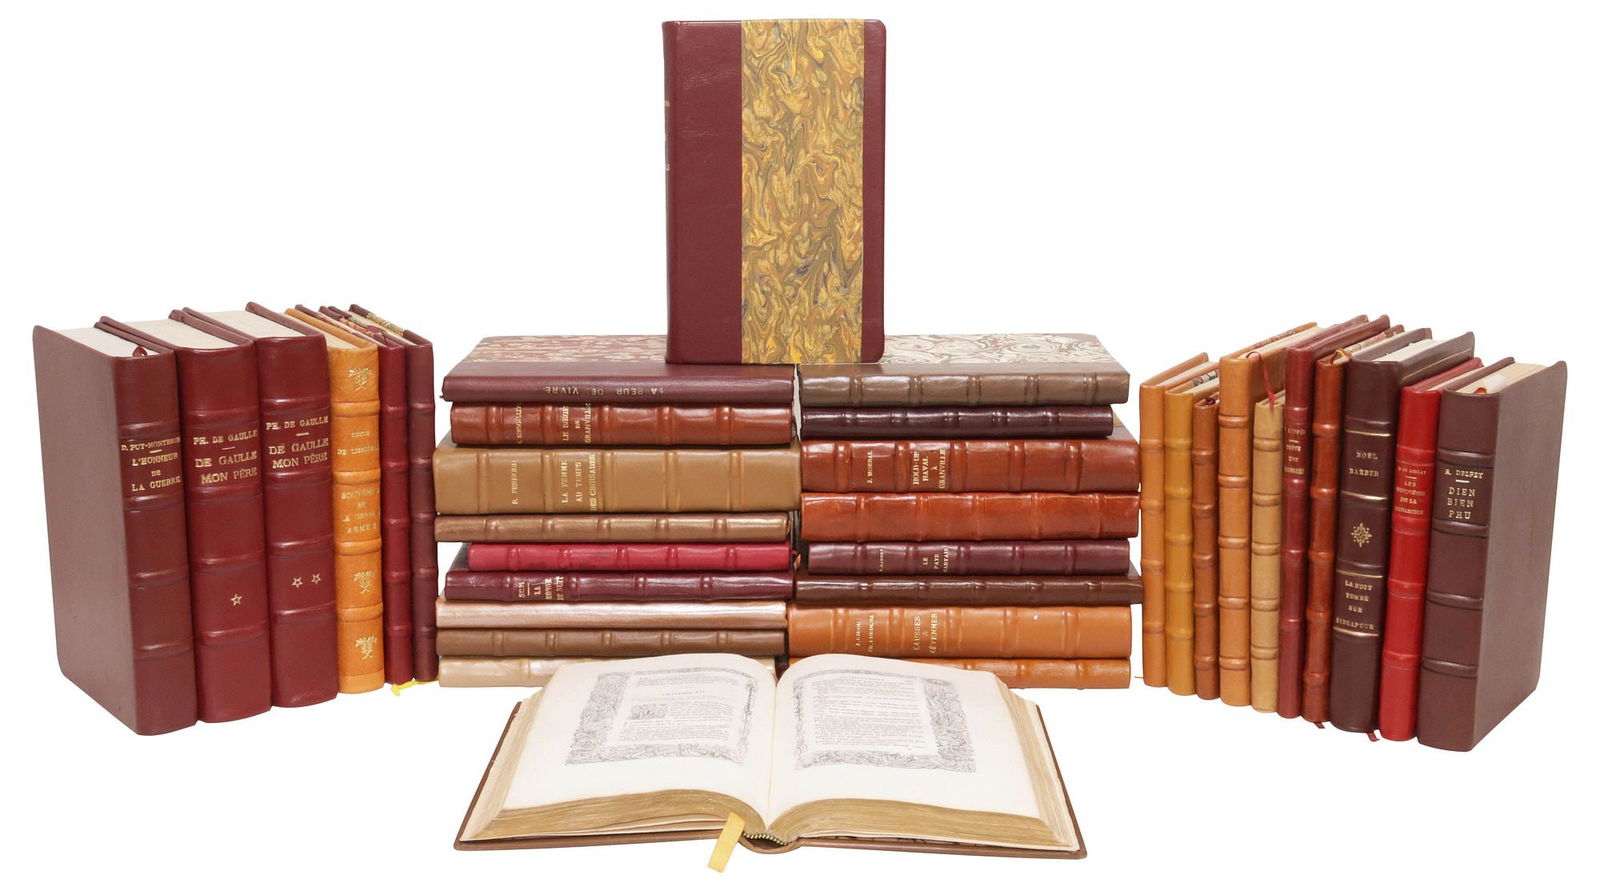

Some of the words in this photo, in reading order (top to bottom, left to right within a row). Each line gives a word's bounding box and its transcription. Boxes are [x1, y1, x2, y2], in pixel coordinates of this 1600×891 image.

[545, 386, 579, 395] VIVRE
[591, 388, 603, 396] DE
[284, 421, 296, 429] DE
[300, 416, 328, 427] GAULLE
[212, 436, 224, 444] DE
[228, 430, 258, 442] GAULLE
[562, 432, 569, 441] LE
[268, 445, 285, 454] DE
[292, 438, 328, 452] GAULLE
[132, 452, 178, 466] L'HONNEUR
[195, 458, 212, 467] DE
[219, 450, 257, 465] GAULLE
[272, 458, 299, 469] MON
[304, 452, 328, 464] PÈRE
[201, 472, 228, 484] MON
[233, 467, 257, 479] PÈRE
[1456, 469, 1484, 479] DELPEY
[132, 484, 145, 492] LA
[150, 476, 181, 489] GUERRE
[1448, 487, 1476, 496] DIEN
[562, 492, 568, 503] LA
[576, 492, 583, 502] AU
[1447, 498, 1474, 508] BIEN
[1448, 510, 1471, 519] PHU
[923, 557, 928, 565] LE
[534, 586, 541, 595] LA
[1354, 583, 1373, 591] NUIT
